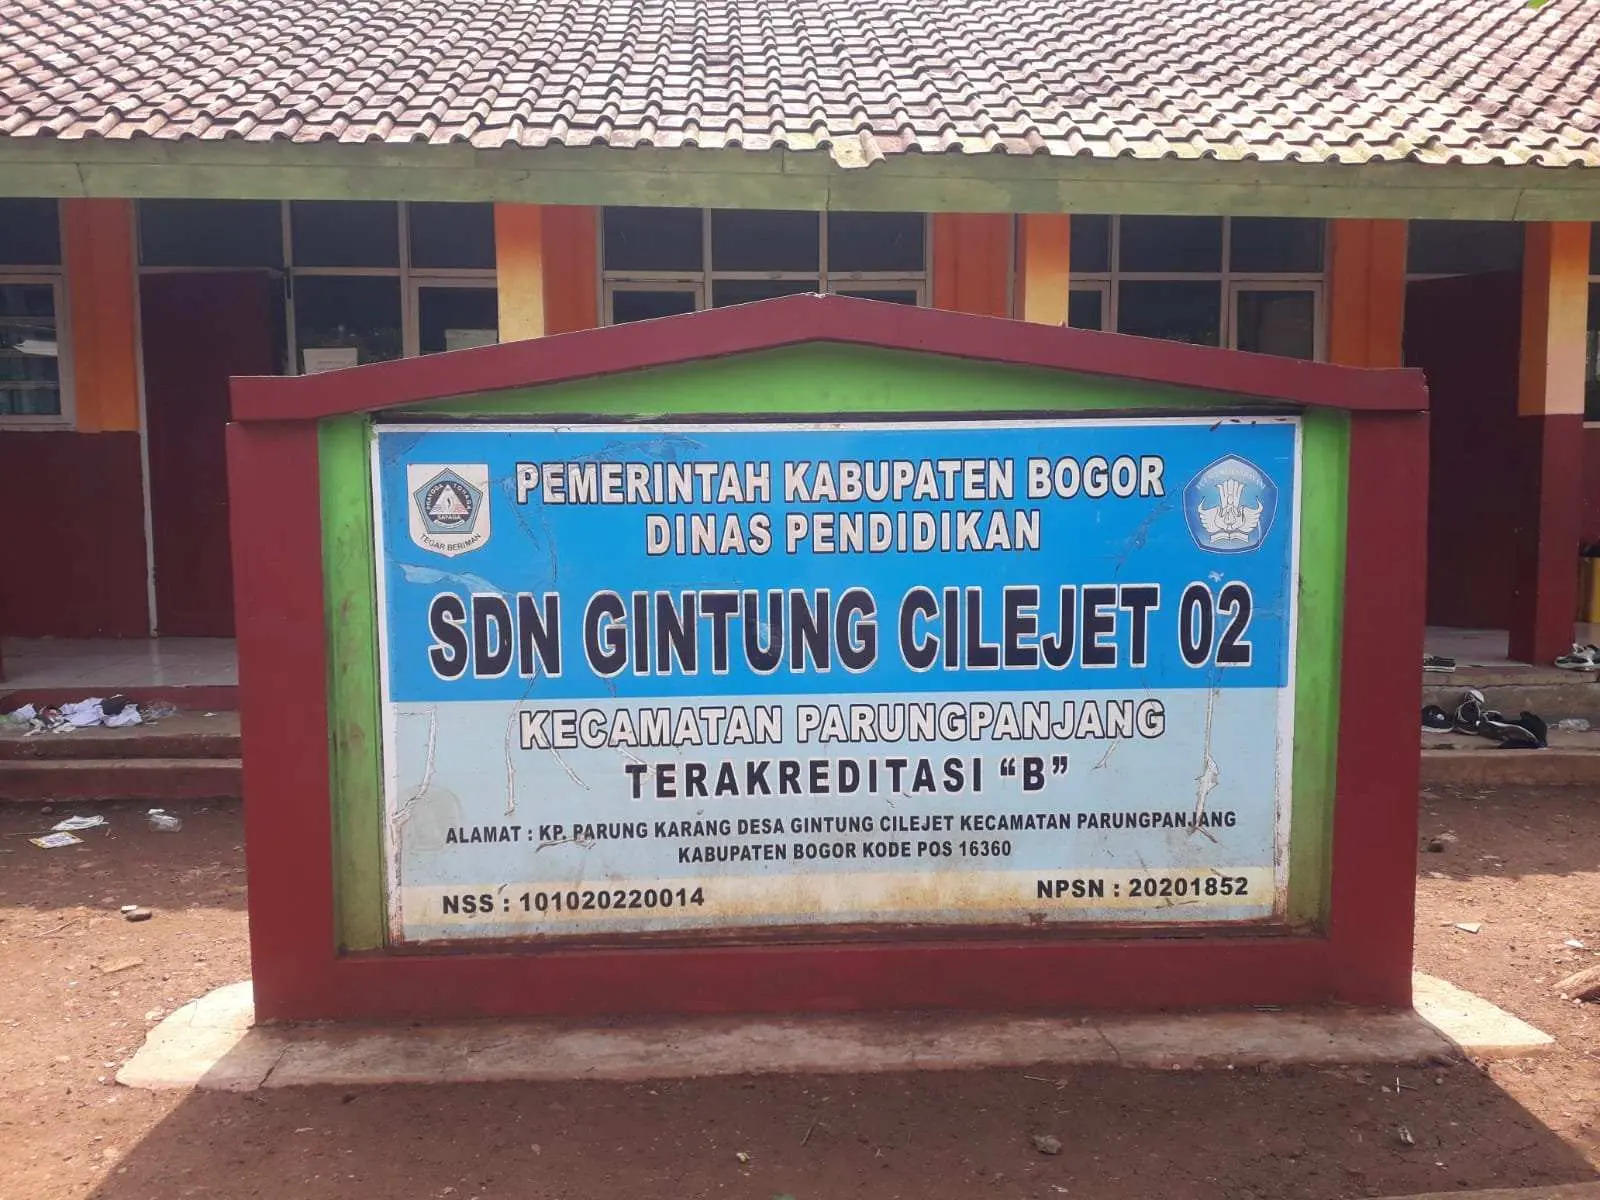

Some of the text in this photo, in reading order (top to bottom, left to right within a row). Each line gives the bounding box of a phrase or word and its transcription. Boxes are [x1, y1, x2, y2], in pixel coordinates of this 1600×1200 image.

[516, 460, 771, 504] PEMERINTAH
[784, 457, 1014, 503] KABUPATEN
[1026, 454, 1166, 500] BOGOR
[420, 532, 482, 552] TEGAR BERIMAN
[646, 508, 1041, 556] DINAS PENDIDIKAN
[427, 580, 1254, 681] SDN GINTUNG CILEJET 02
[518, 698, 1166, 750] KECAMATAN PARUNGPANJANG
[625, 756, 982, 800] TERAKREDITASI
[445, 825, 521, 845] ALAMAT
[538, 824, 567, 841] KP.
[573, 822, 649, 841] PARUNG
[654, 819, 731, 838] KARANG
[737, 818, 785, 836] DESA
[790, 816, 874, 834] GINTUNG
[879, 815, 954, 833] CILEJET
[960, 813, 1071, 832] KECAMATAN
[1076, 811, 1237, 830] PARUNGPANJANG
[678, 840, 1012, 864] KABUPATEN BOGOR KODE POS 16360
[442, 894, 494, 915] NSS
[519, 887, 705, 912] 101020220014
[1036, 879, 1104, 899] NPSN
[1128, 876, 1249, 898] 20201852
